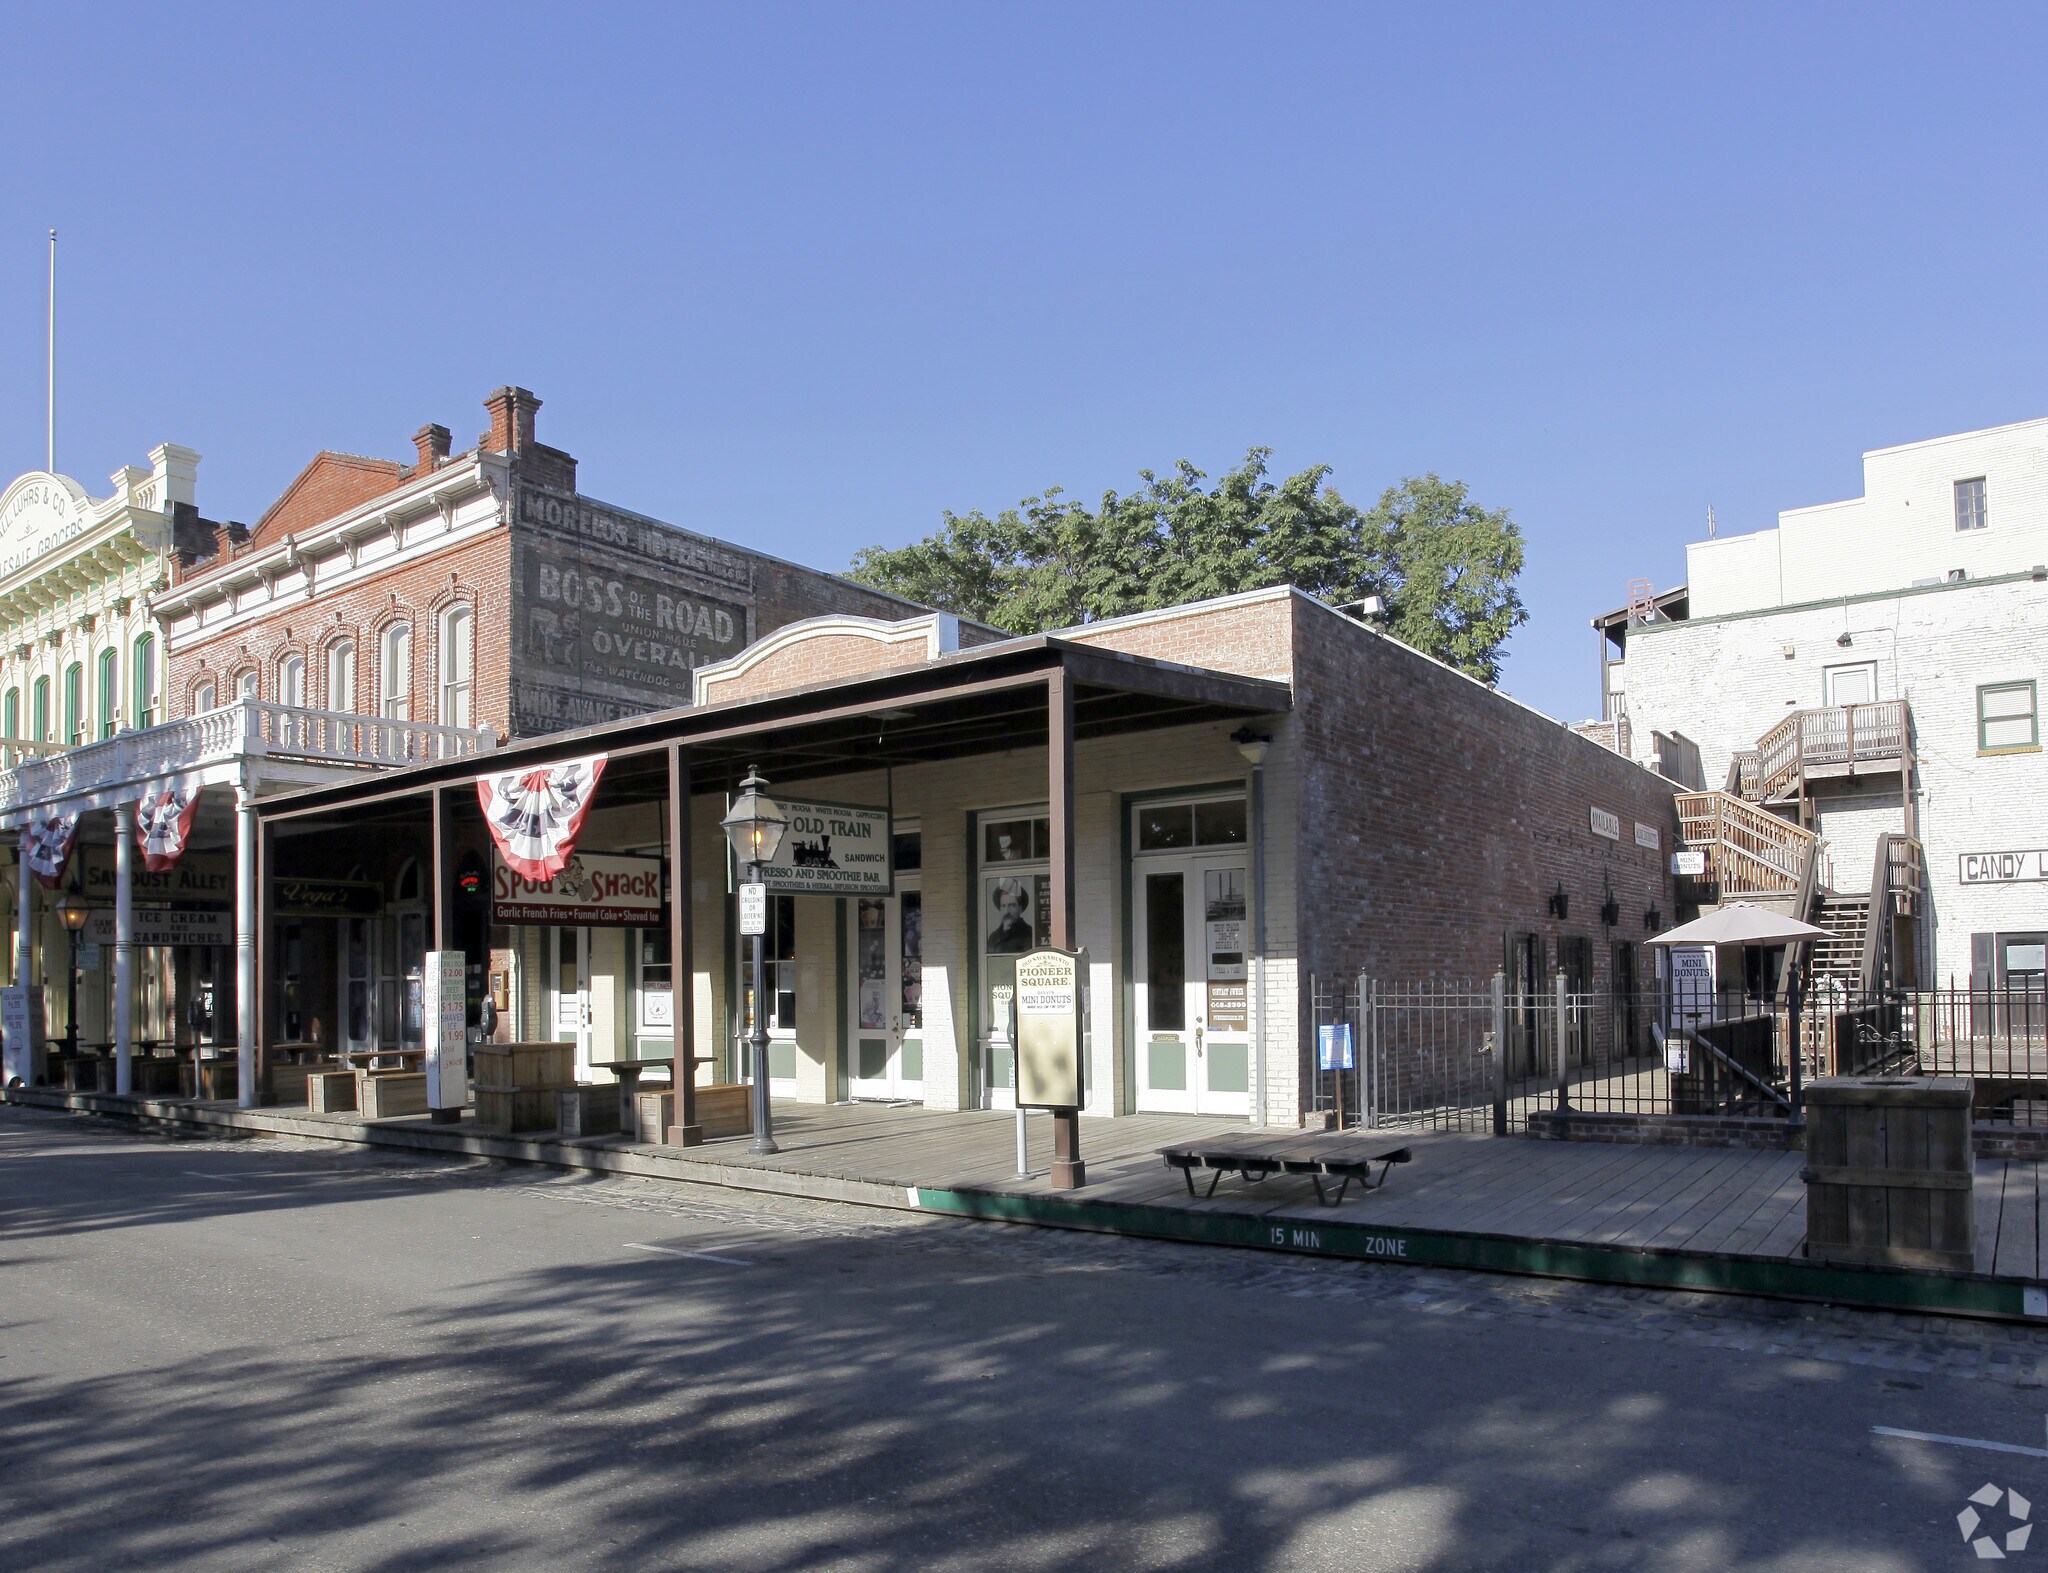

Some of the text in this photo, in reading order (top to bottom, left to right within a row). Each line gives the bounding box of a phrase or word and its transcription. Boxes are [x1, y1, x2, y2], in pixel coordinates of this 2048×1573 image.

[12, 486, 40, 518] LUHRS
[42, 486, 50, 505] &
[539, 562, 734, 644] BOSS OF ROAD
[628, 604, 652, 621] THE
[608, 666, 671, 688] WATCHDOG
[791, 803, 812, 813] MOCHA
[793, 816, 872, 838] OLD TRAIN
[1592, 811, 1619, 836] AVAILABLE
[844, 854, 885, 863] SANDWICH
[1966, 854, 2025, 880] CANDY
[179, 867, 228, 889] ALLEY
[795, 868, 815, 880] AND
[816, 869, 862, 882] SMOOTHIE
[863, 872, 880, 883] BAR
[771, 880, 805, 889] SMOOTHIES
[748, 887, 757, 895] NO
[138, 912, 218, 923] ICE CREAM
[497, 906, 660, 922] Garlic French Fries Funnel Cake Shaved Ice
[133, 932, 223, 943] SANDWICHES
[1681, 960, 1702, 968] MINI
[448, 968, 463, 977] 2.00
[1019, 967, 1073, 977] PIONEER
[1674, 969, 1710, 977] DONUTS
[991, 991, 1012, 1000] SQU
[1021, 995, 1072, 1004] MINI DONUTS
[447, 1001, 464, 1011] 1.75
[441, 1013, 465, 1022] SHAVED
[447, 1022, 458, 1031] ICE
[448, 1030, 464, 1041] 1.99
[1270, 1228, 1407, 1257] 15 MIN ZONE
